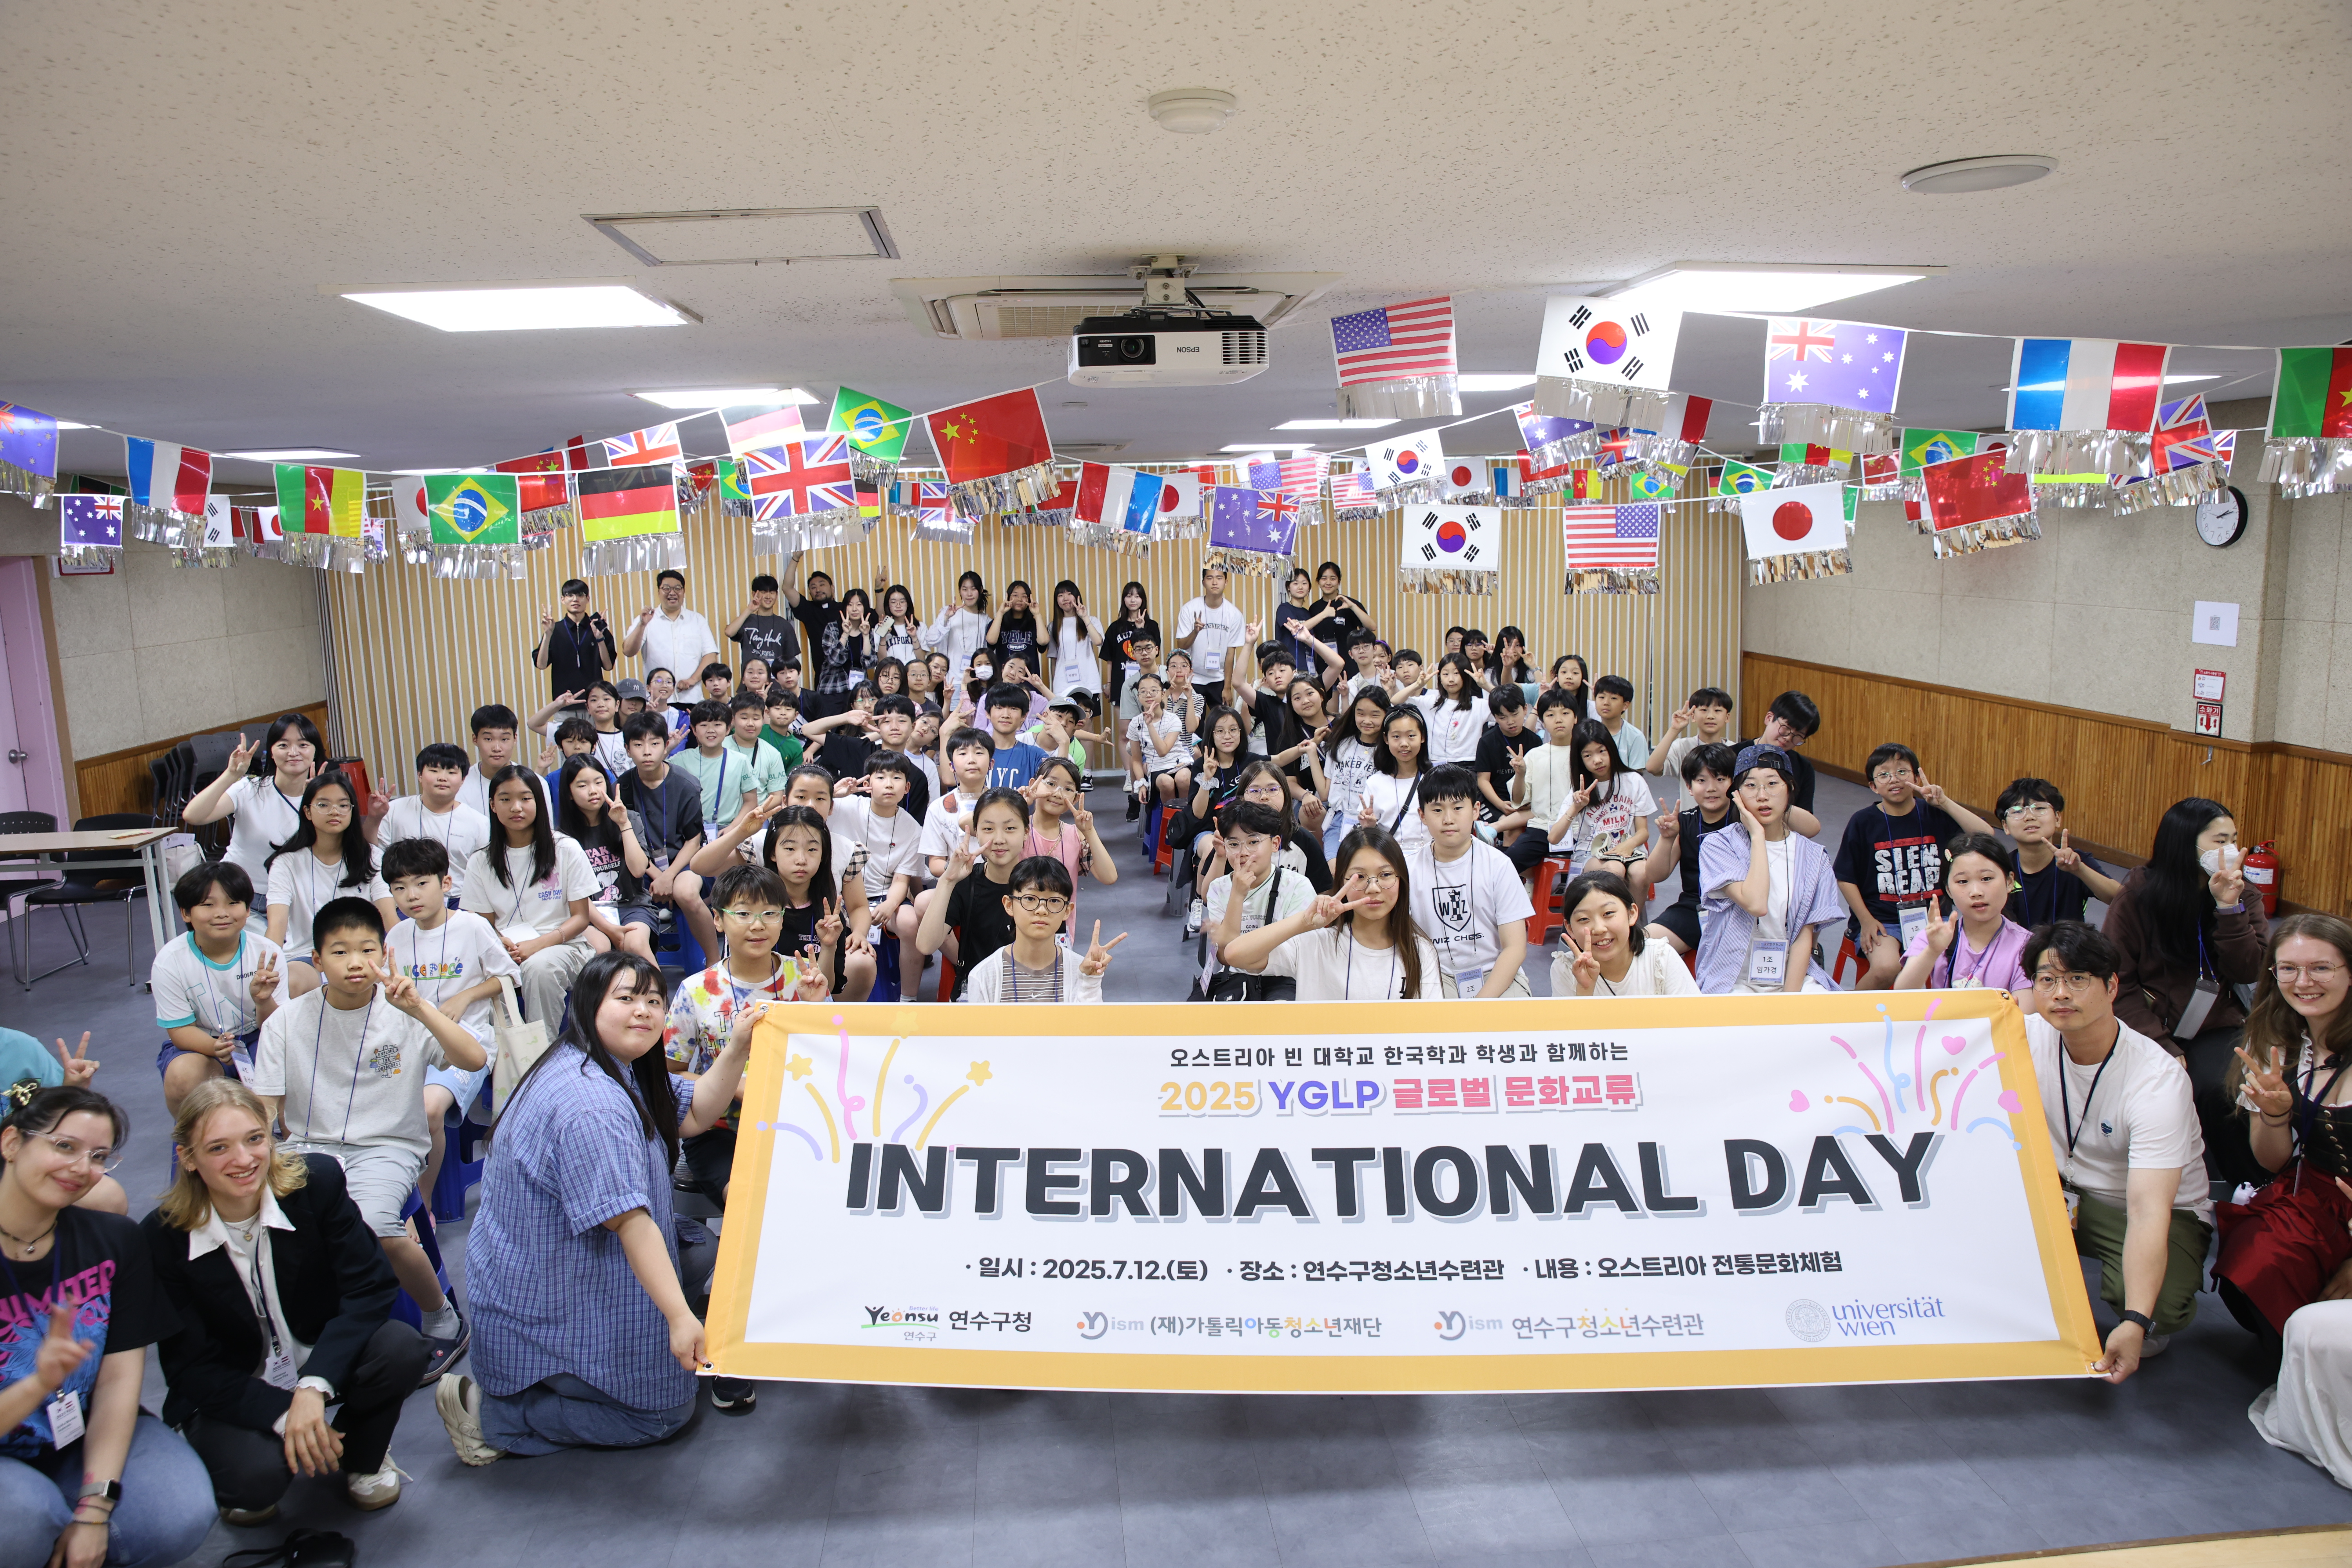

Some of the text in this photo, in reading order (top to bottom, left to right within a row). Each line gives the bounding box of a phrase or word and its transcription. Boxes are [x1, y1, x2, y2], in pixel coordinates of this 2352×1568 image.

[1001, 630, 1032, 645] YALE
[1593, 808, 1608, 824] GRADE
[1602, 815, 1626, 826] MILK
[1877, 866, 1941, 895] REAP
[1171, 1042, 1628, 1067] 오스트리아 빈 대학교 한국학과 학생과 함께하는
[378, 1063, 398, 1071] OUTDOORS
[1160, 1074, 1636, 1111] 2025 YGLP 글로벌 문화교류
[846, 1131, 1938, 1218] INTERNATIONAL DAY
[1043, 1258, 1208, 1281] 2025.7.12.(토)
[1303, 1260, 1504, 1281] 연수구청소년수련관
[1597, 1256, 1707, 1277] 오스트리아
[1711, 1250, 1843, 1276] 전통문화체험
[865, 1306, 938, 1325] Yeonsu
[1832, 1296, 1945, 1321] universität
[949, 1310, 1032, 1333] 연수구청
[1150, 1316, 1382, 1338] (재)가톨릭아동청소년재단
[1512, 1312, 1704, 1339] 연수구청소년수련관
[1837, 1320, 1896, 1337] wien
[904, 1332, 937, 1341] 연수구
